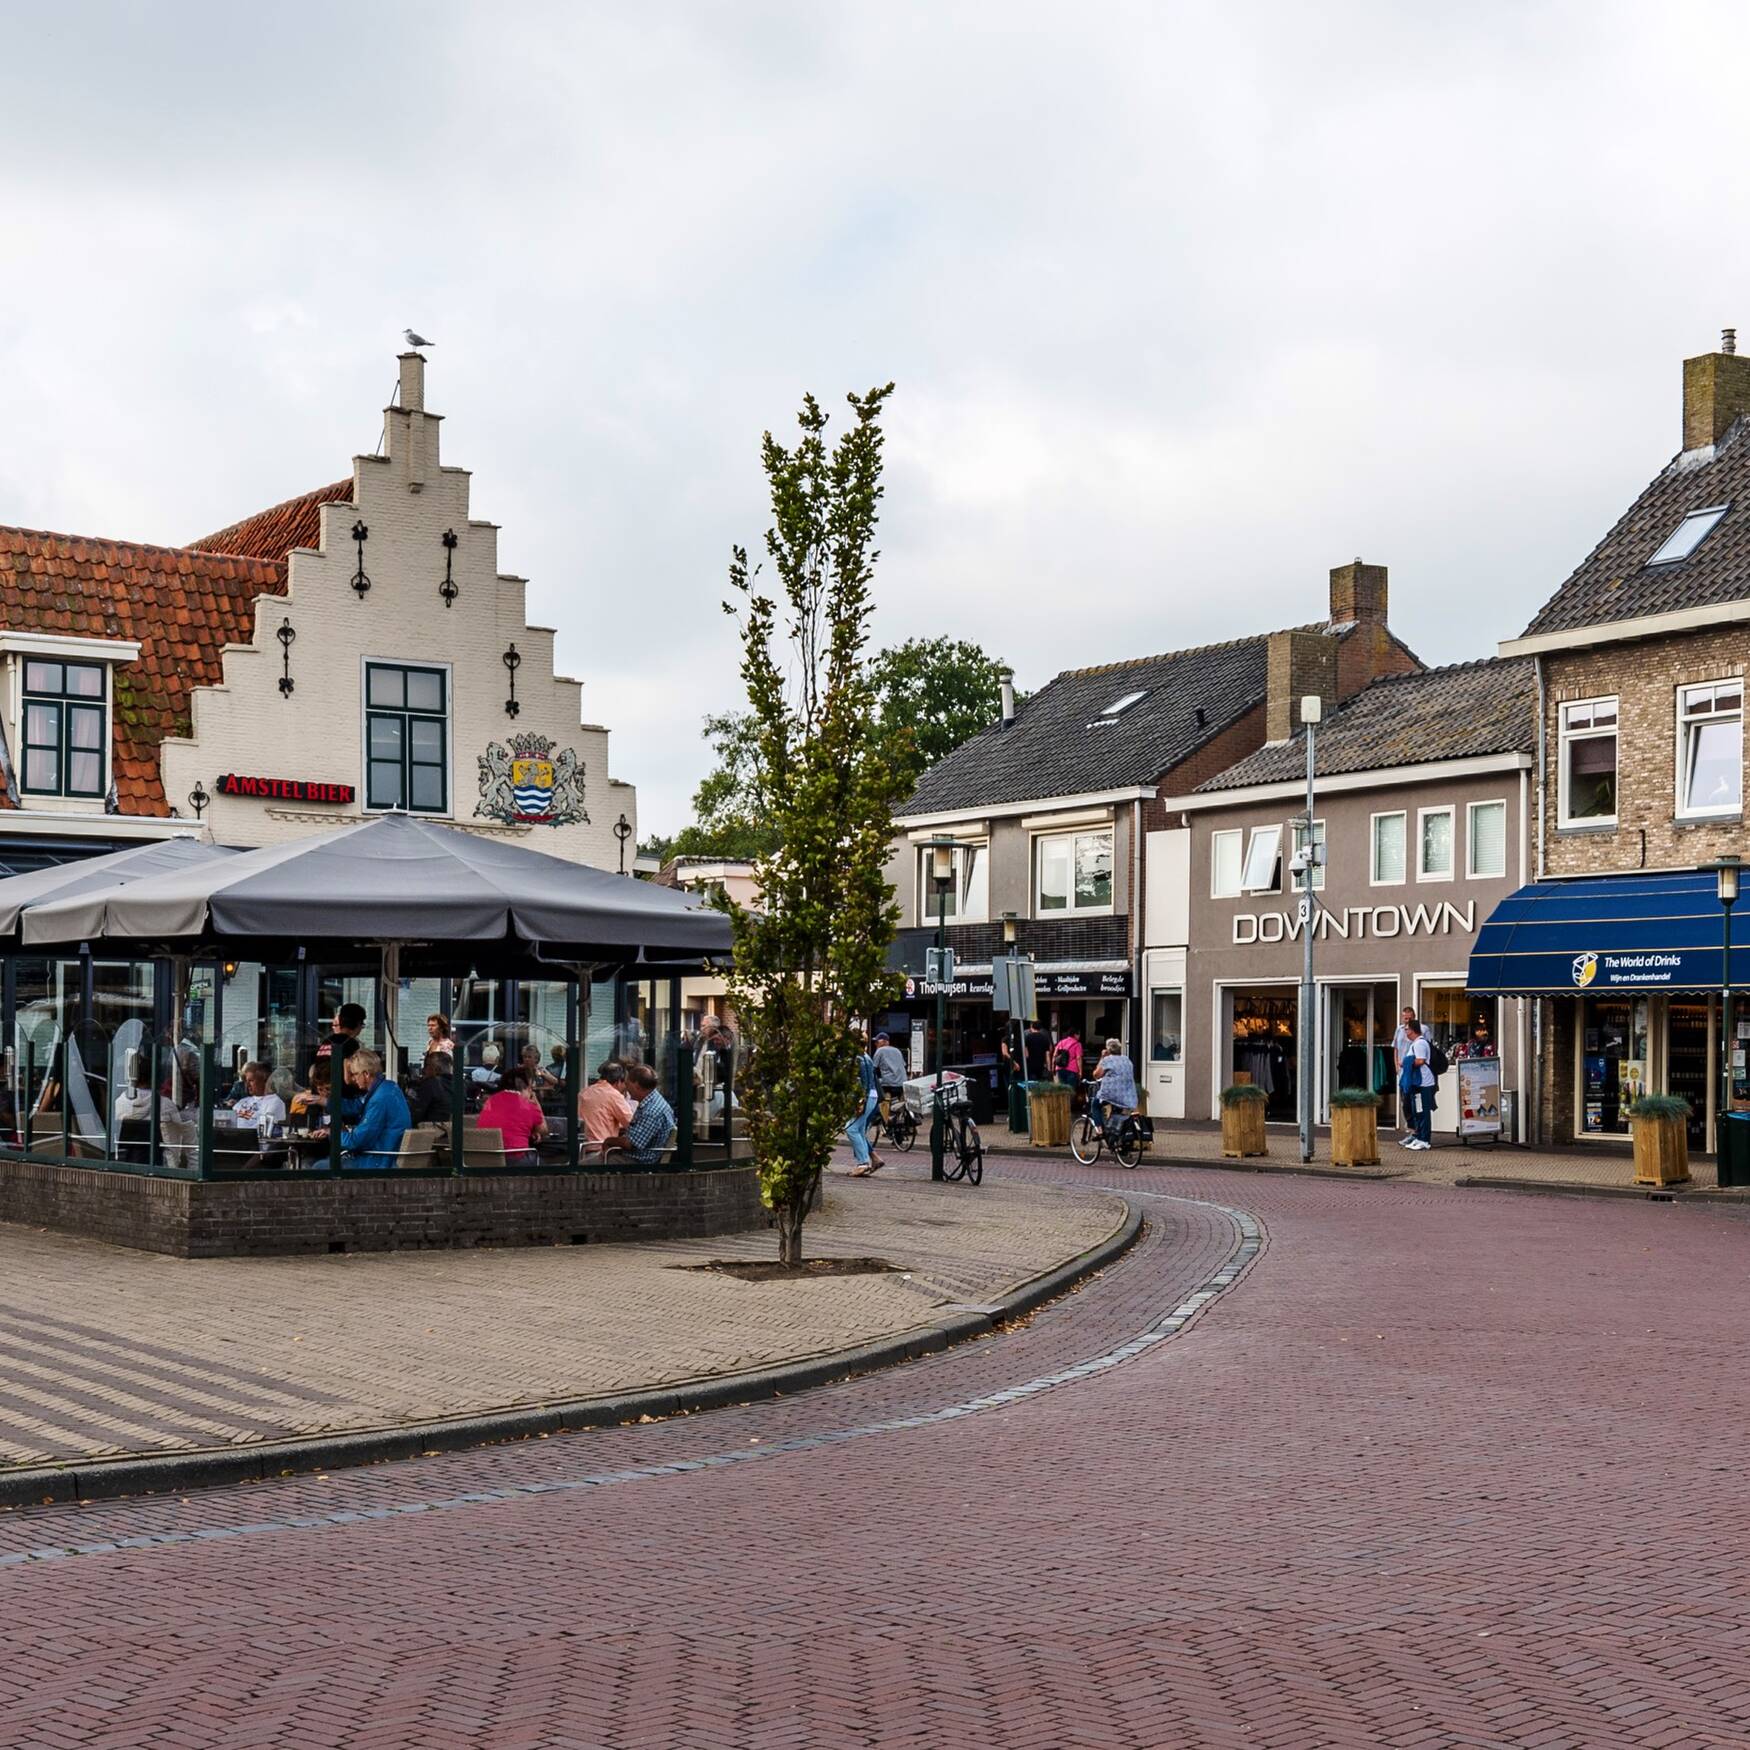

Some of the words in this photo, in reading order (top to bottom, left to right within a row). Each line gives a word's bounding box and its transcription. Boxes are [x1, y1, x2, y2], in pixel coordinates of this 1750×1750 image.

[224, 773, 303, 799] AMSTEL
[306, 782, 353, 804] BIER
[1232, 900, 1476, 944] DOWNTOWN
[1300, 904, 1307, 918] 3
[1604, 957, 1619, 968] The
[1620, 956, 1643, 968] World
[1645, 955, 1655, 967] of
[1655, 955, 1681, 967] Drinks
